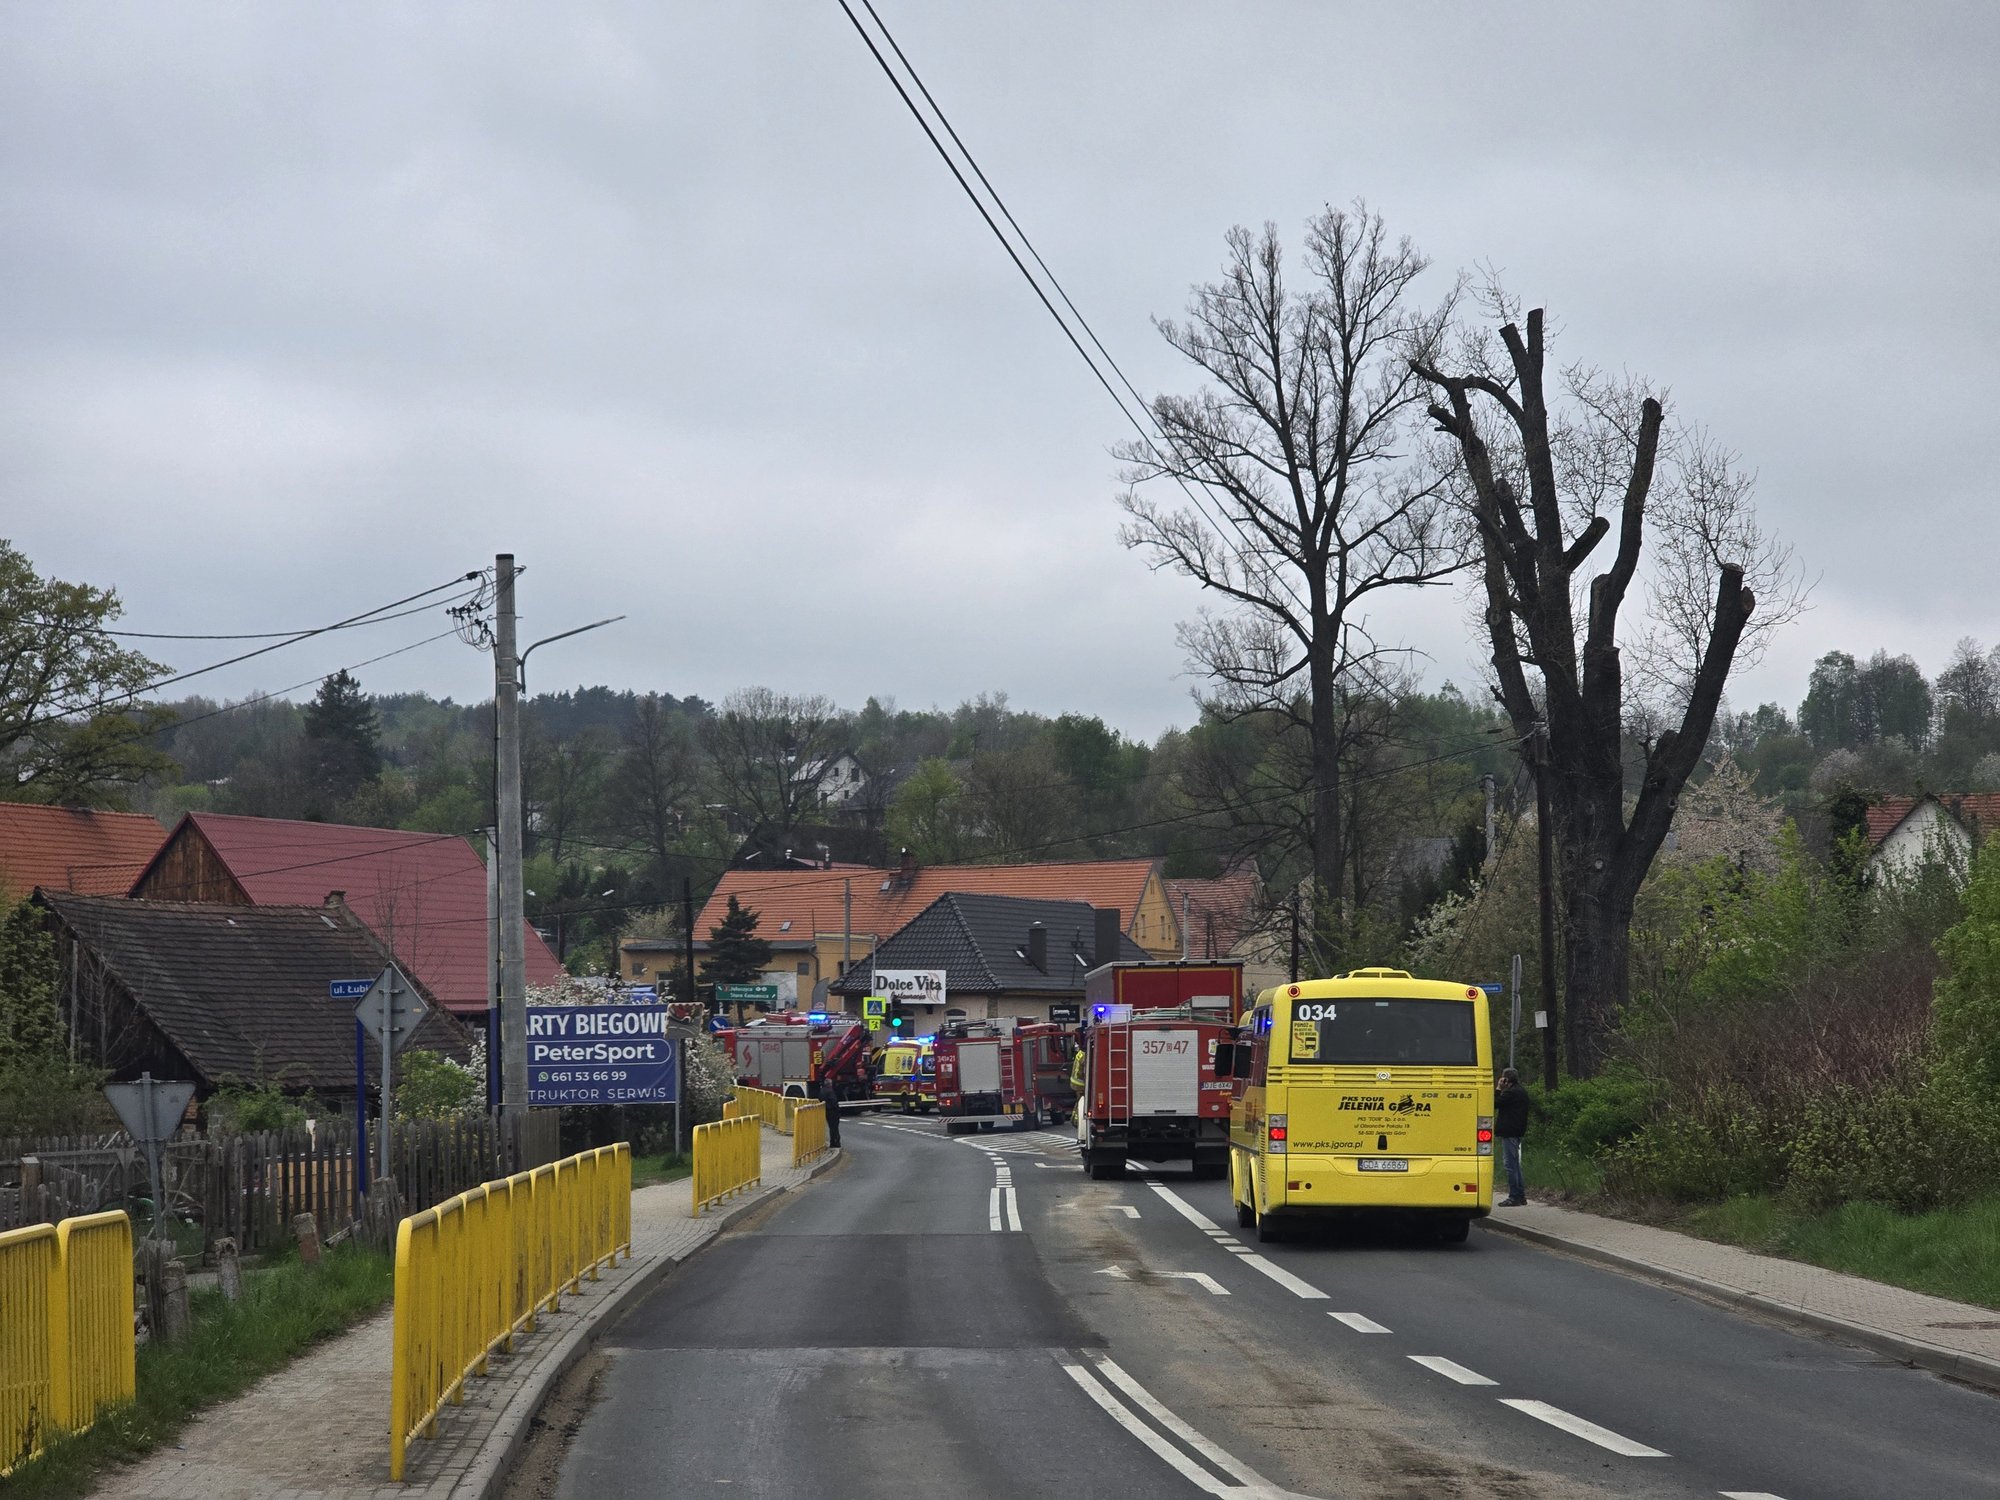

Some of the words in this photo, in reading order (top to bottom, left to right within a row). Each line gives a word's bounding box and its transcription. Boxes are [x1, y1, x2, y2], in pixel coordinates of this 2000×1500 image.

[875, 975, 913, 990] Dolce
[914, 975, 942, 990] Vita
[333, 986, 345, 994] ul.
[1298, 1004, 1337, 1021] 034
[534, 1043, 655, 1063] PeterSport
[551, 1072, 572, 1082] 661
[575, 1071, 590, 1082] 53
[592, 1071, 609, 1081] 66
[611, 1070, 627, 1081] 99
[607, 1087, 667, 1099] SERWIS
[1338, 1101, 1385, 1111] JELENIA
[1293, 1141, 1363, 1149] www.pks.jgora.pl
